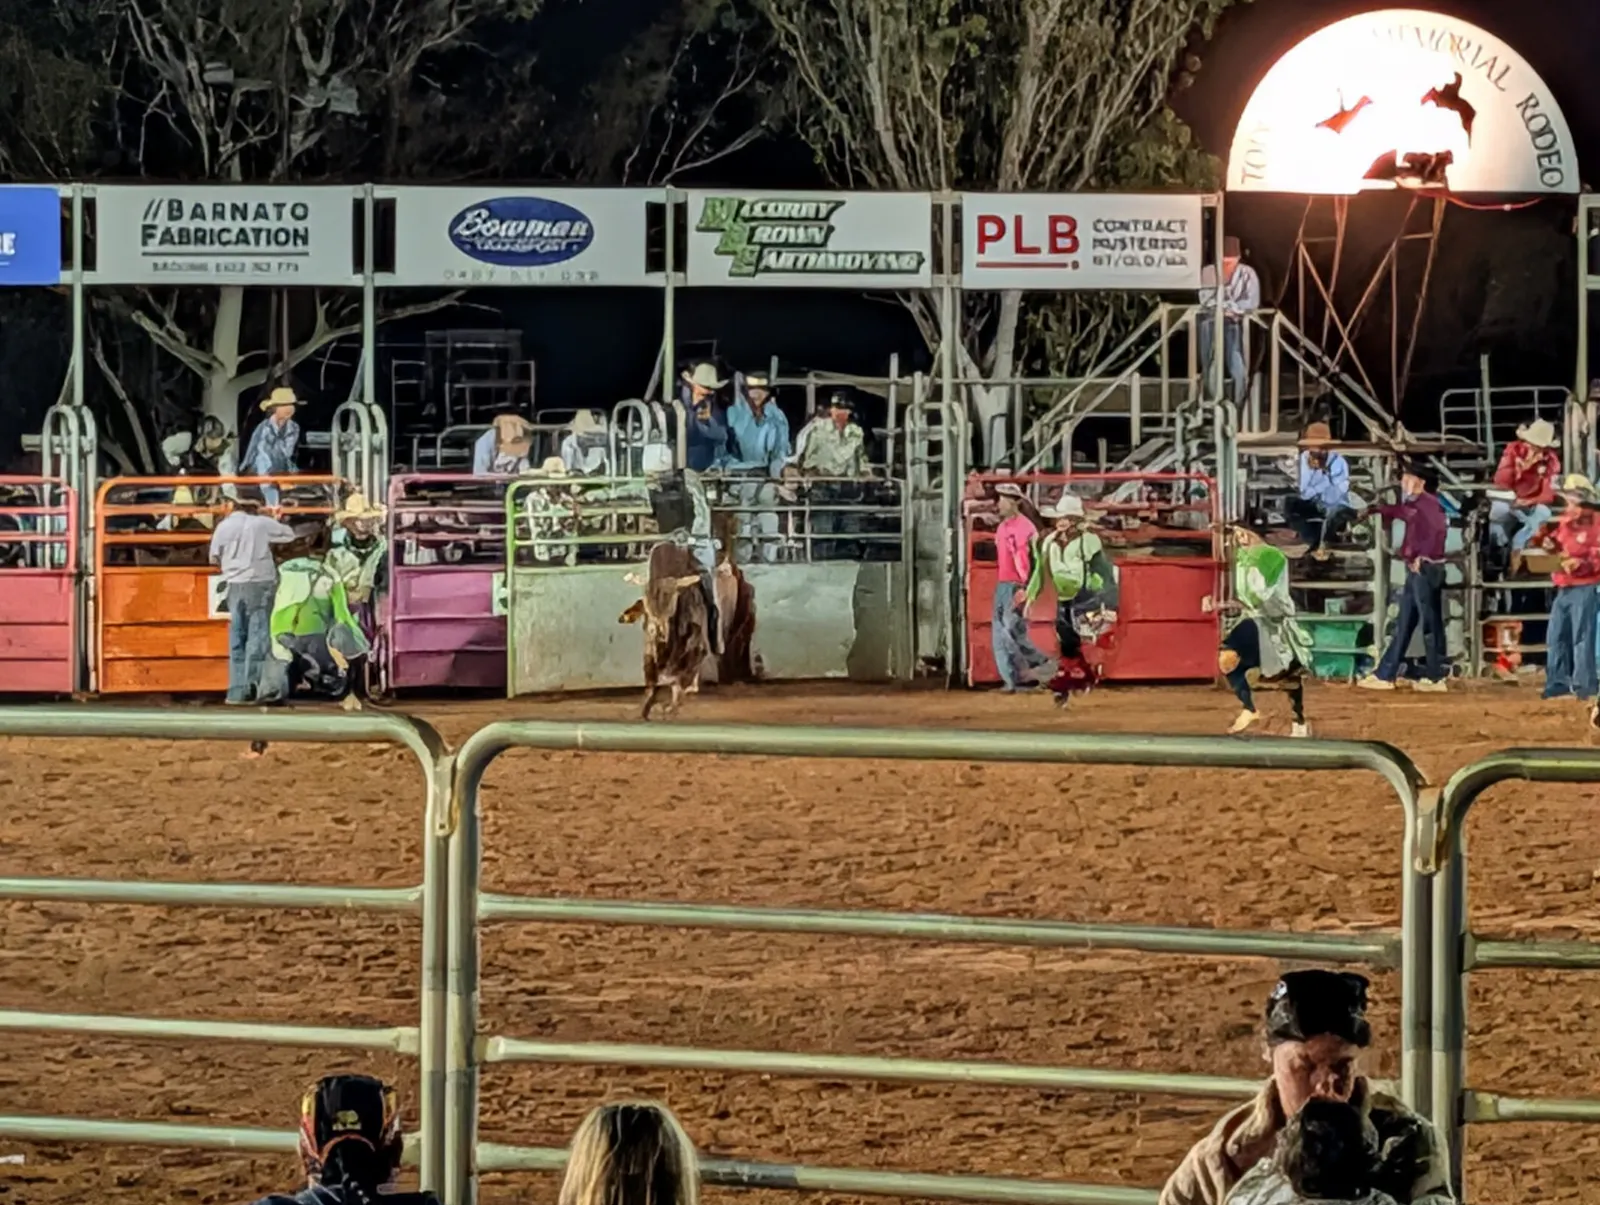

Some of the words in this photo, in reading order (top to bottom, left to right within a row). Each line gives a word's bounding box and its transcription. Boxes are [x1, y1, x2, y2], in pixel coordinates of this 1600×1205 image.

[1516, 92, 1564, 188] RODEO
[141, 224, 310, 247] FABRICATION
[453, 207, 589, 237] Bowman
[976, 214, 1080, 255] PLB
[1092, 219, 1188, 233] CONTRACT
[0, 231, 16, 255] E
